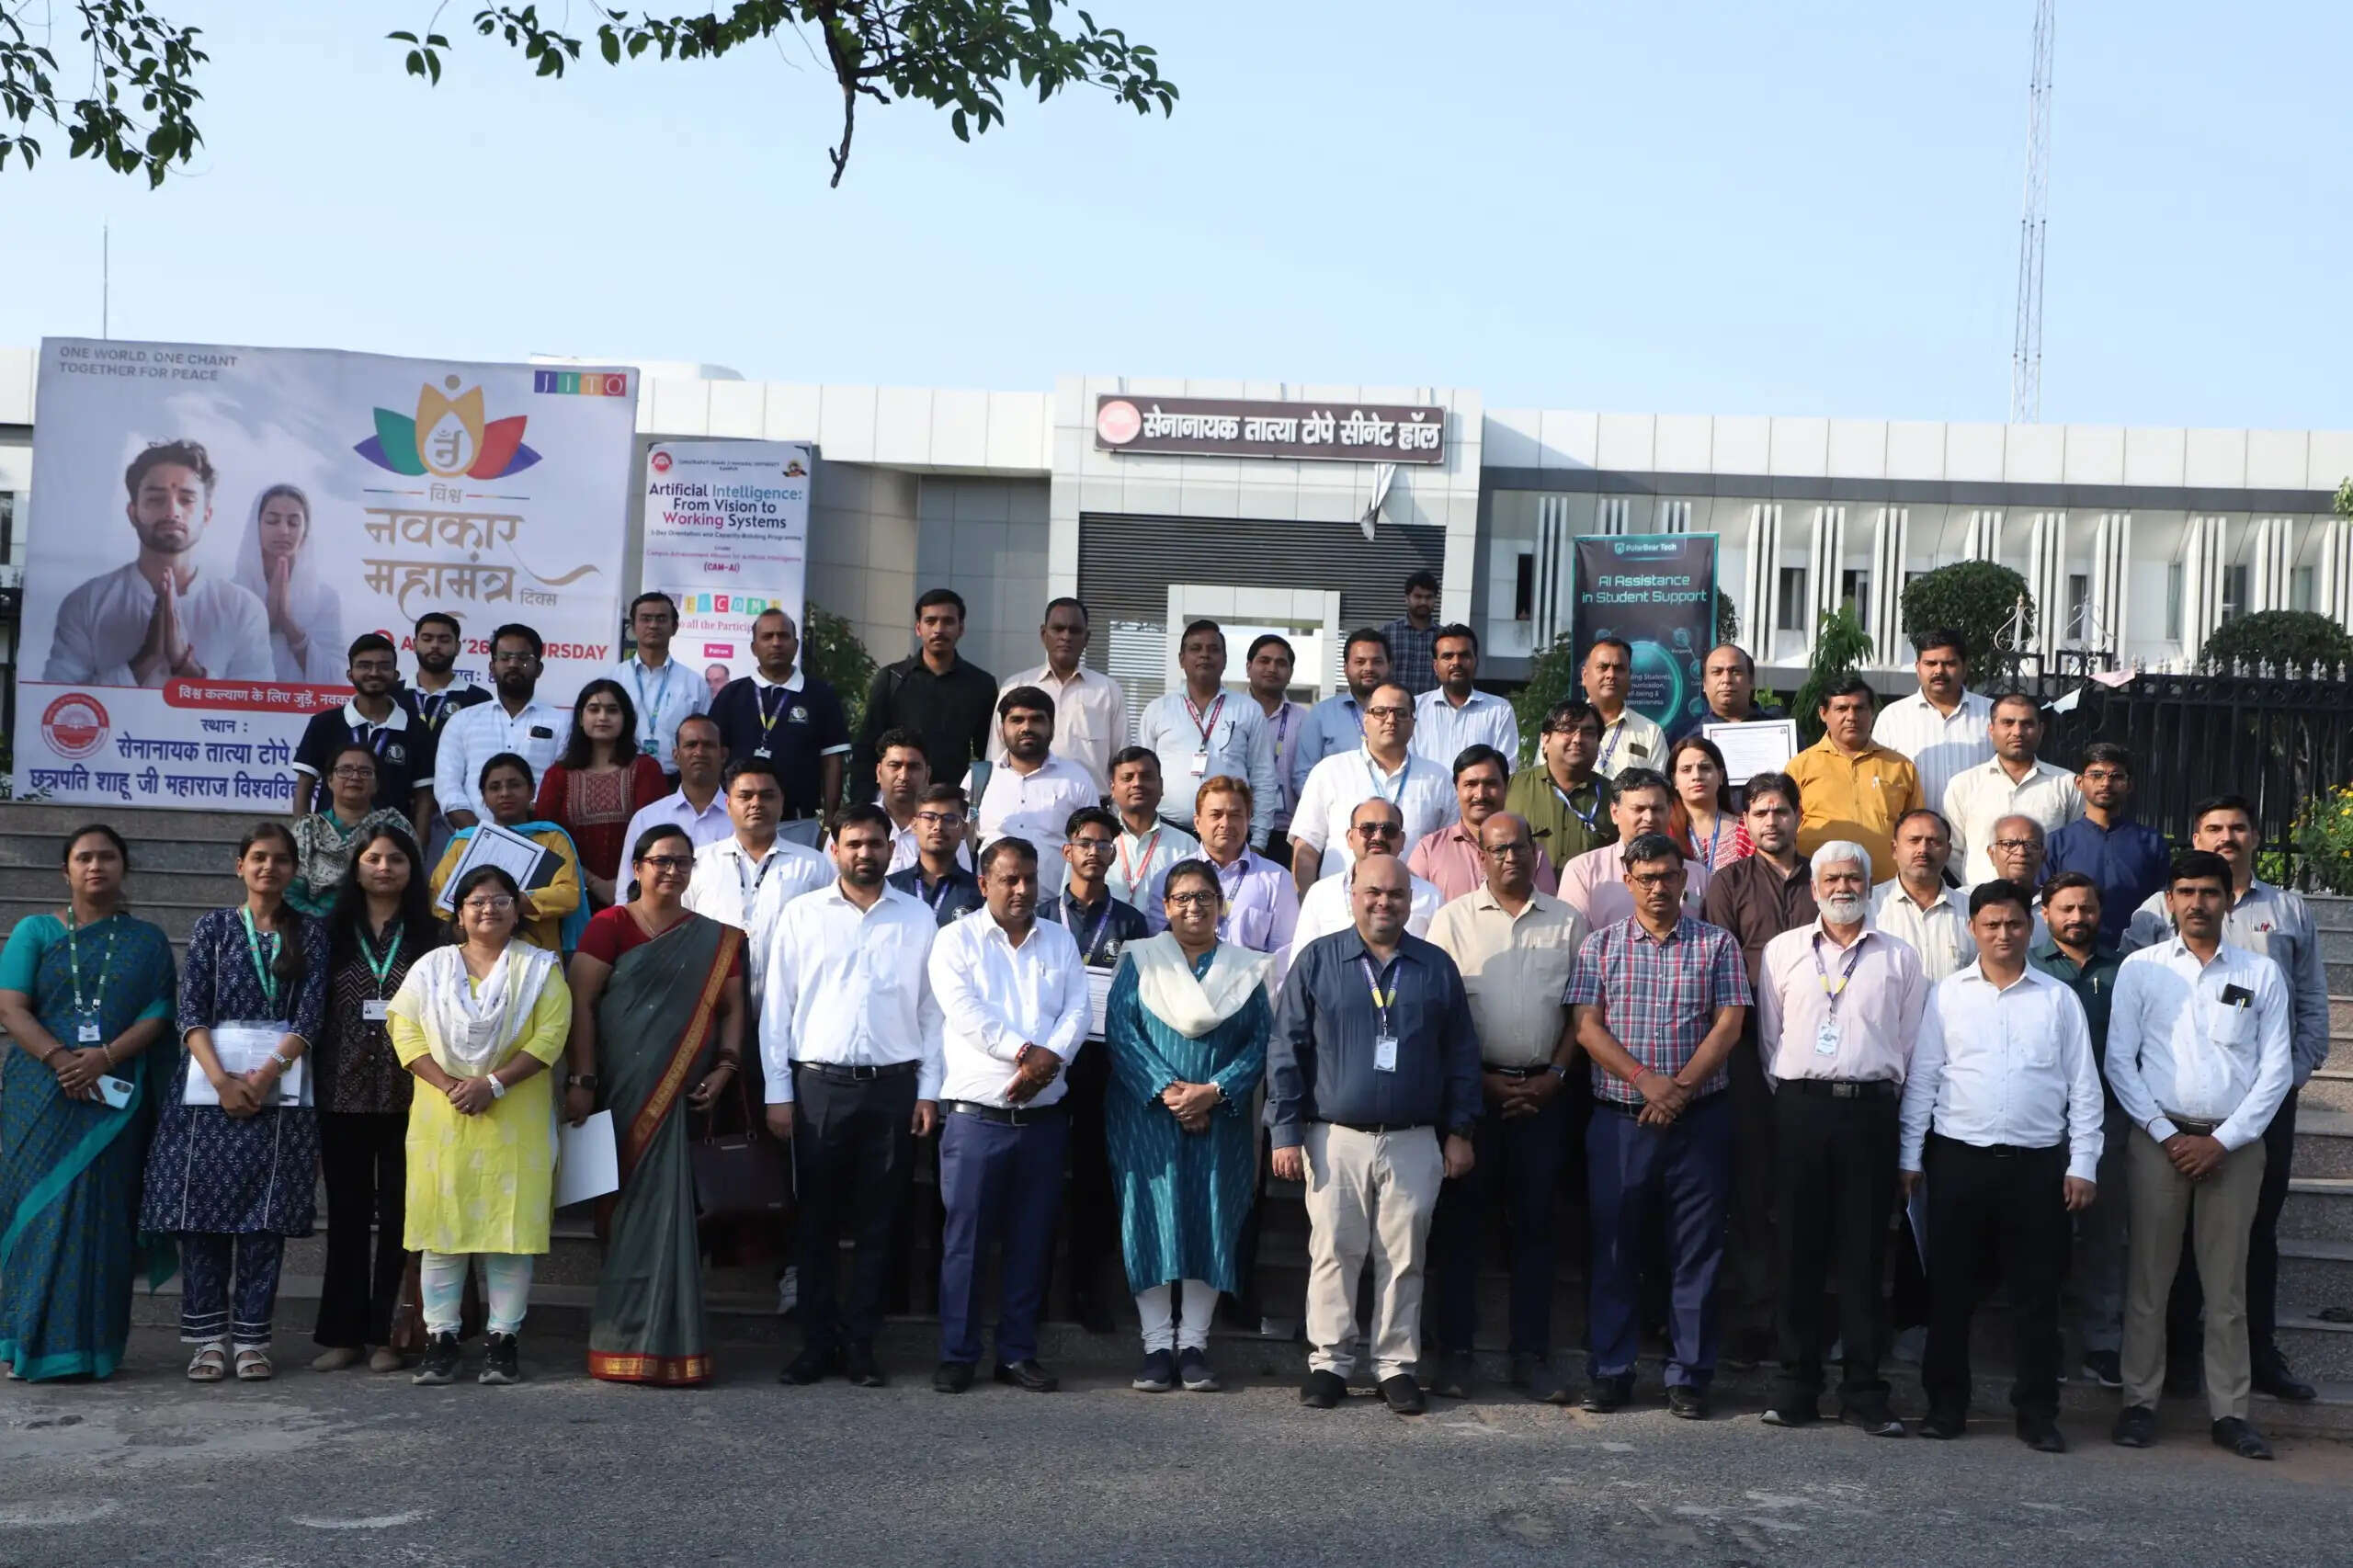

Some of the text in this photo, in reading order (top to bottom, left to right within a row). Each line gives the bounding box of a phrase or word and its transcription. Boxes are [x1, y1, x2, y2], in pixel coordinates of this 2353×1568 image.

[60, 346, 90, 359] ONE
[153, 351, 184, 364] ONE
[188, 354, 238, 368] CHANT
[59, 361, 219, 381] TOGETHER FOR PEACE
[542, 372, 624, 394] JITO
[1142, 403, 1441, 449] सेनानायक तात्या टोपे सीनेट हॉल
[429, 483, 463, 504] विश्व
[649, 483, 802, 502] Artificial Intelligence:
[673, 497, 777, 514] From Vision to
[363, 507, 526, 550] नवकार
[663, 512, 787, 530] Working Systems
[703, 562, 740, 574] (CAM-AI)
[362, 551, 558, 610] महामंत्र दिवस
[1598, 574, 1690, 587] AI Assistance
[1582, 589, 1707, 606] in Student Support
[687, 619, 699, 630] all
[700, 619, 715, 631] the
[178, 684, 202, 699] विश्व
[205, 688, 248, 701] कल्याण
[251, 687, 265, 701] के
[267, 687, 291, 704] लिए
[199, 719, 237, 733] स्थान
[116, 732, 200, 762] सेनानायक
[205, 740, 252, 766] तात्या
[256, 737, 290, 766] टोपे
[28, 763, 90, 791] छत्रपति
[94, 771, 132, 801] शाहू
[137, 766, 160, 794] जी
[165, 774, 230, 799] महाराज
